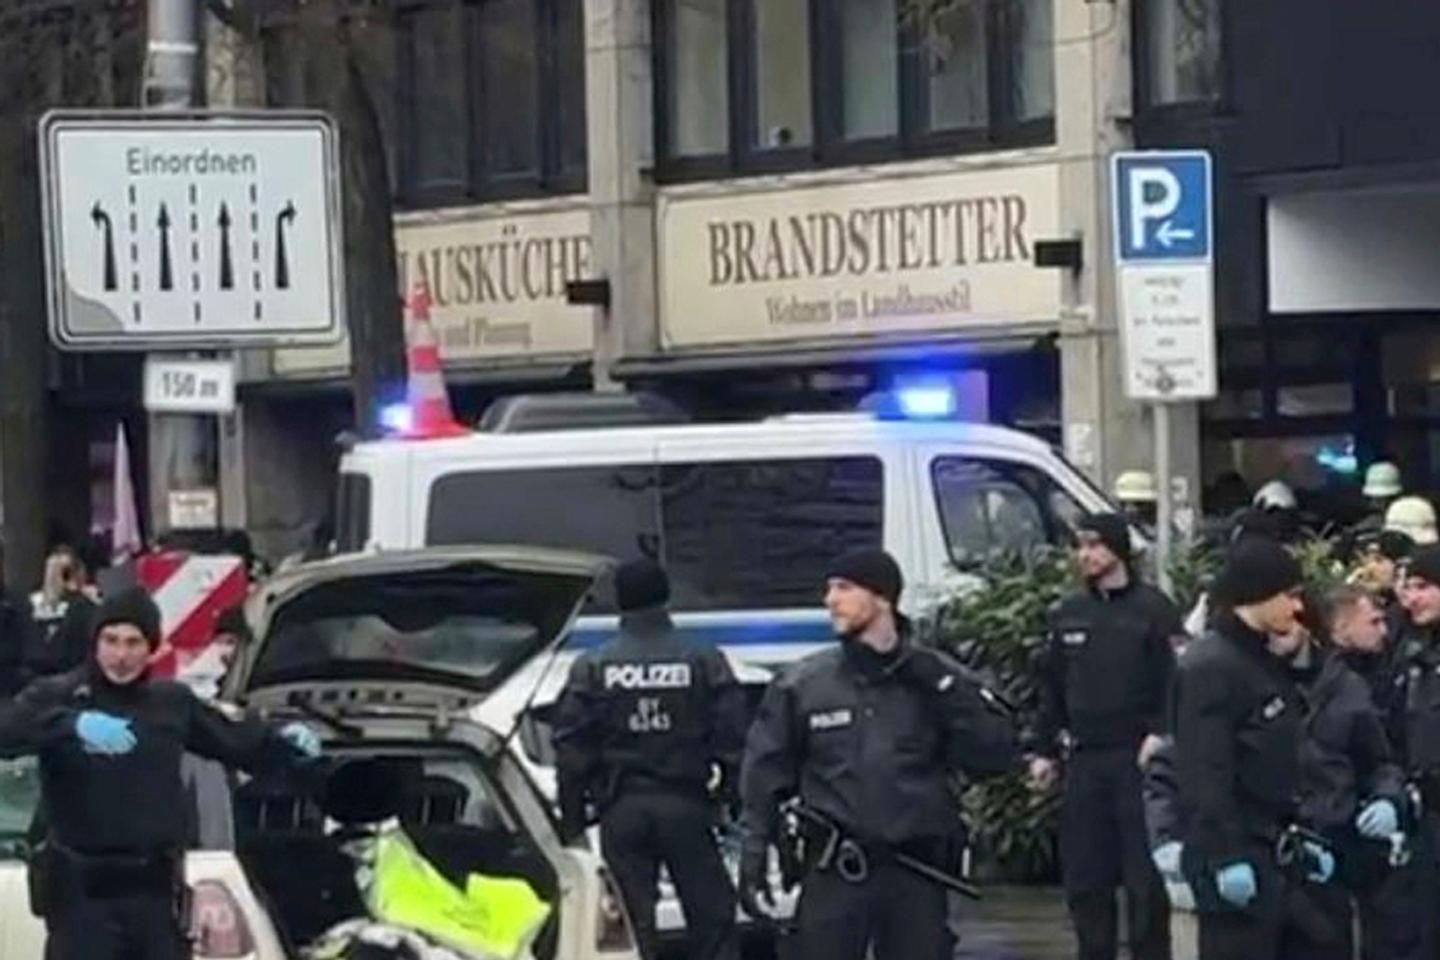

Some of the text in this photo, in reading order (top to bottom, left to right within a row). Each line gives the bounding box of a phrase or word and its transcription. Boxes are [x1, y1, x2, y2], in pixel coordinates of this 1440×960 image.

[126, 147, 257, 174] Einordnen
[1129, 167, 1181, 248] P
[707, 194, 1031, 287] BRANDSTETTER
[604, 662, 692, 690] POLIZEI
